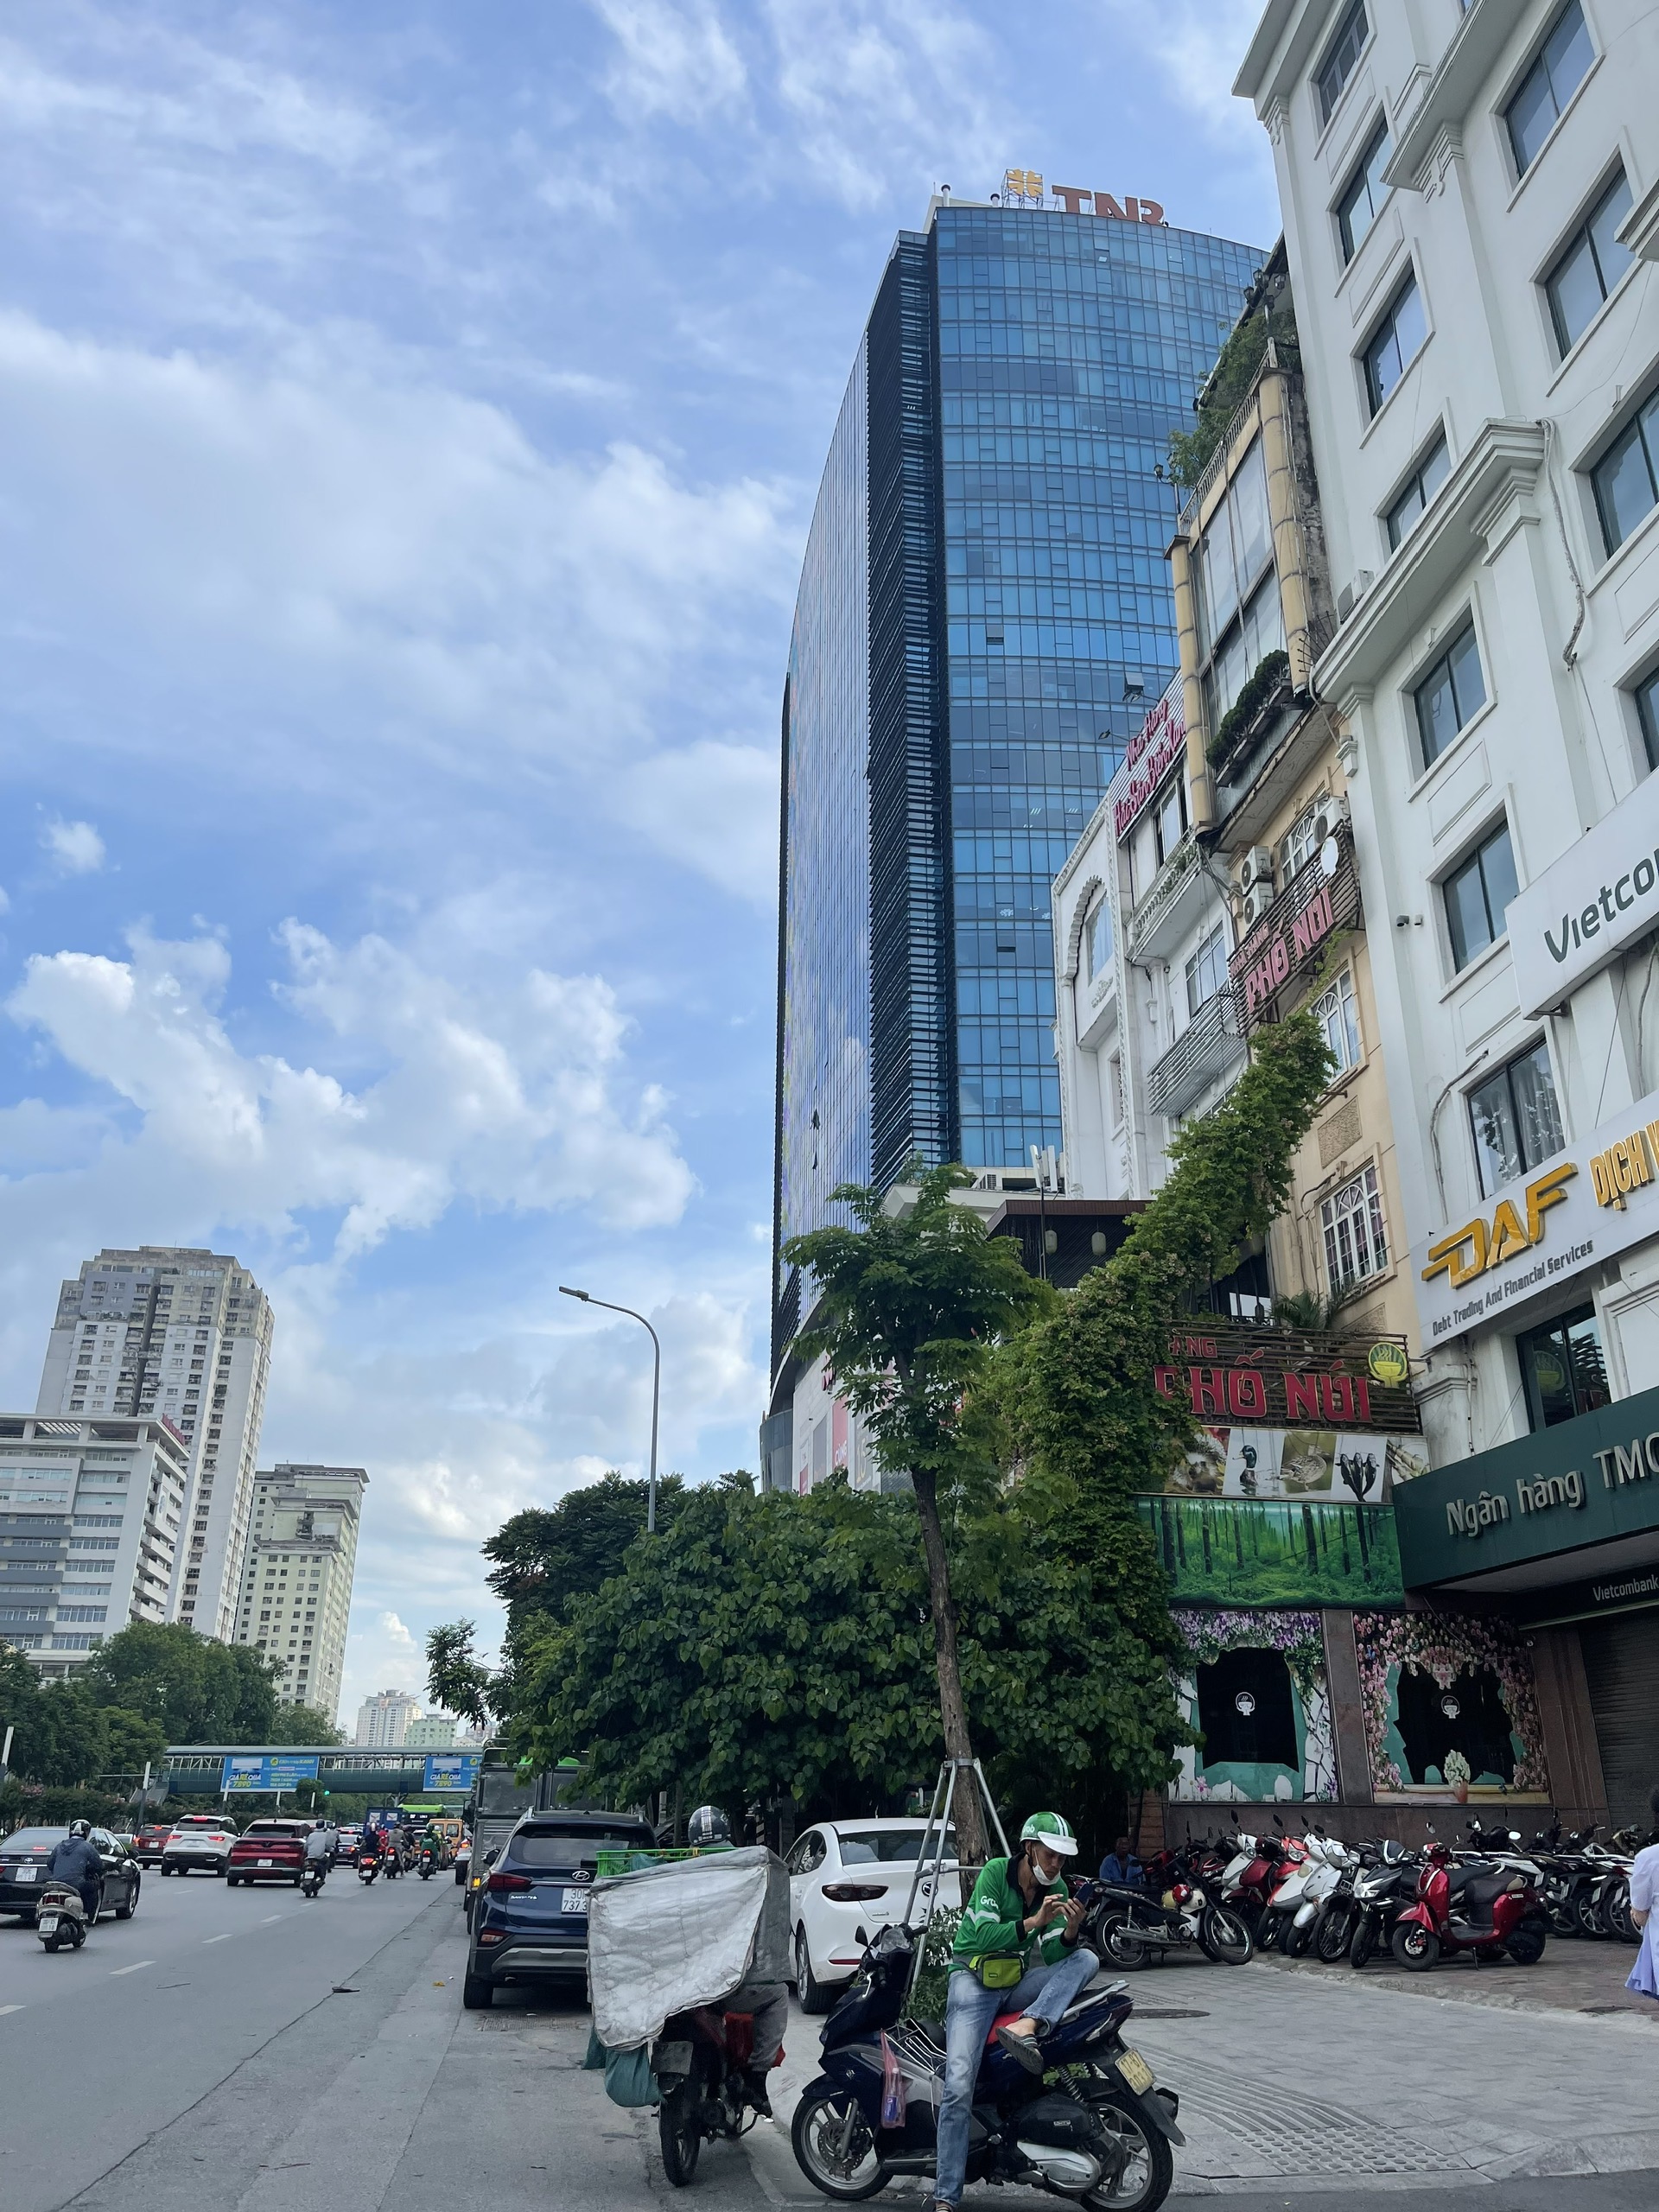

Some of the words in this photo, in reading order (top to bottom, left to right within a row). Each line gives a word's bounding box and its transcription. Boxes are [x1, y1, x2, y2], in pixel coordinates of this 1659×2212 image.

[1052, 185, 1164, 226] TNR
[1292, 884, 1335, 962] NÚI
[1589, 1130, 1652, 1211] DỊCH
[1421, 1162, 1578, 1289] DAF
[1433, 1316, 1452, 1337] Debt
[1453, 1298, 1484, 1325] Trading
[1485, 1285, 1503, 1308] And
[1503, 1262, 1547, 1298] Financial
[1548, 1239, 1594, 1274] Services
[1281, 1359, 1373, 1424] NÚI
[1446, 1491, 1510, 1538] Ngân
[1516, 1470, 1586, 1509] hàng
[1592, 1573, 1659, 1602] Vietcombank
[563, 1900, 588, 1911] 737.3
[980, 1895, 999, 1910] Gra
